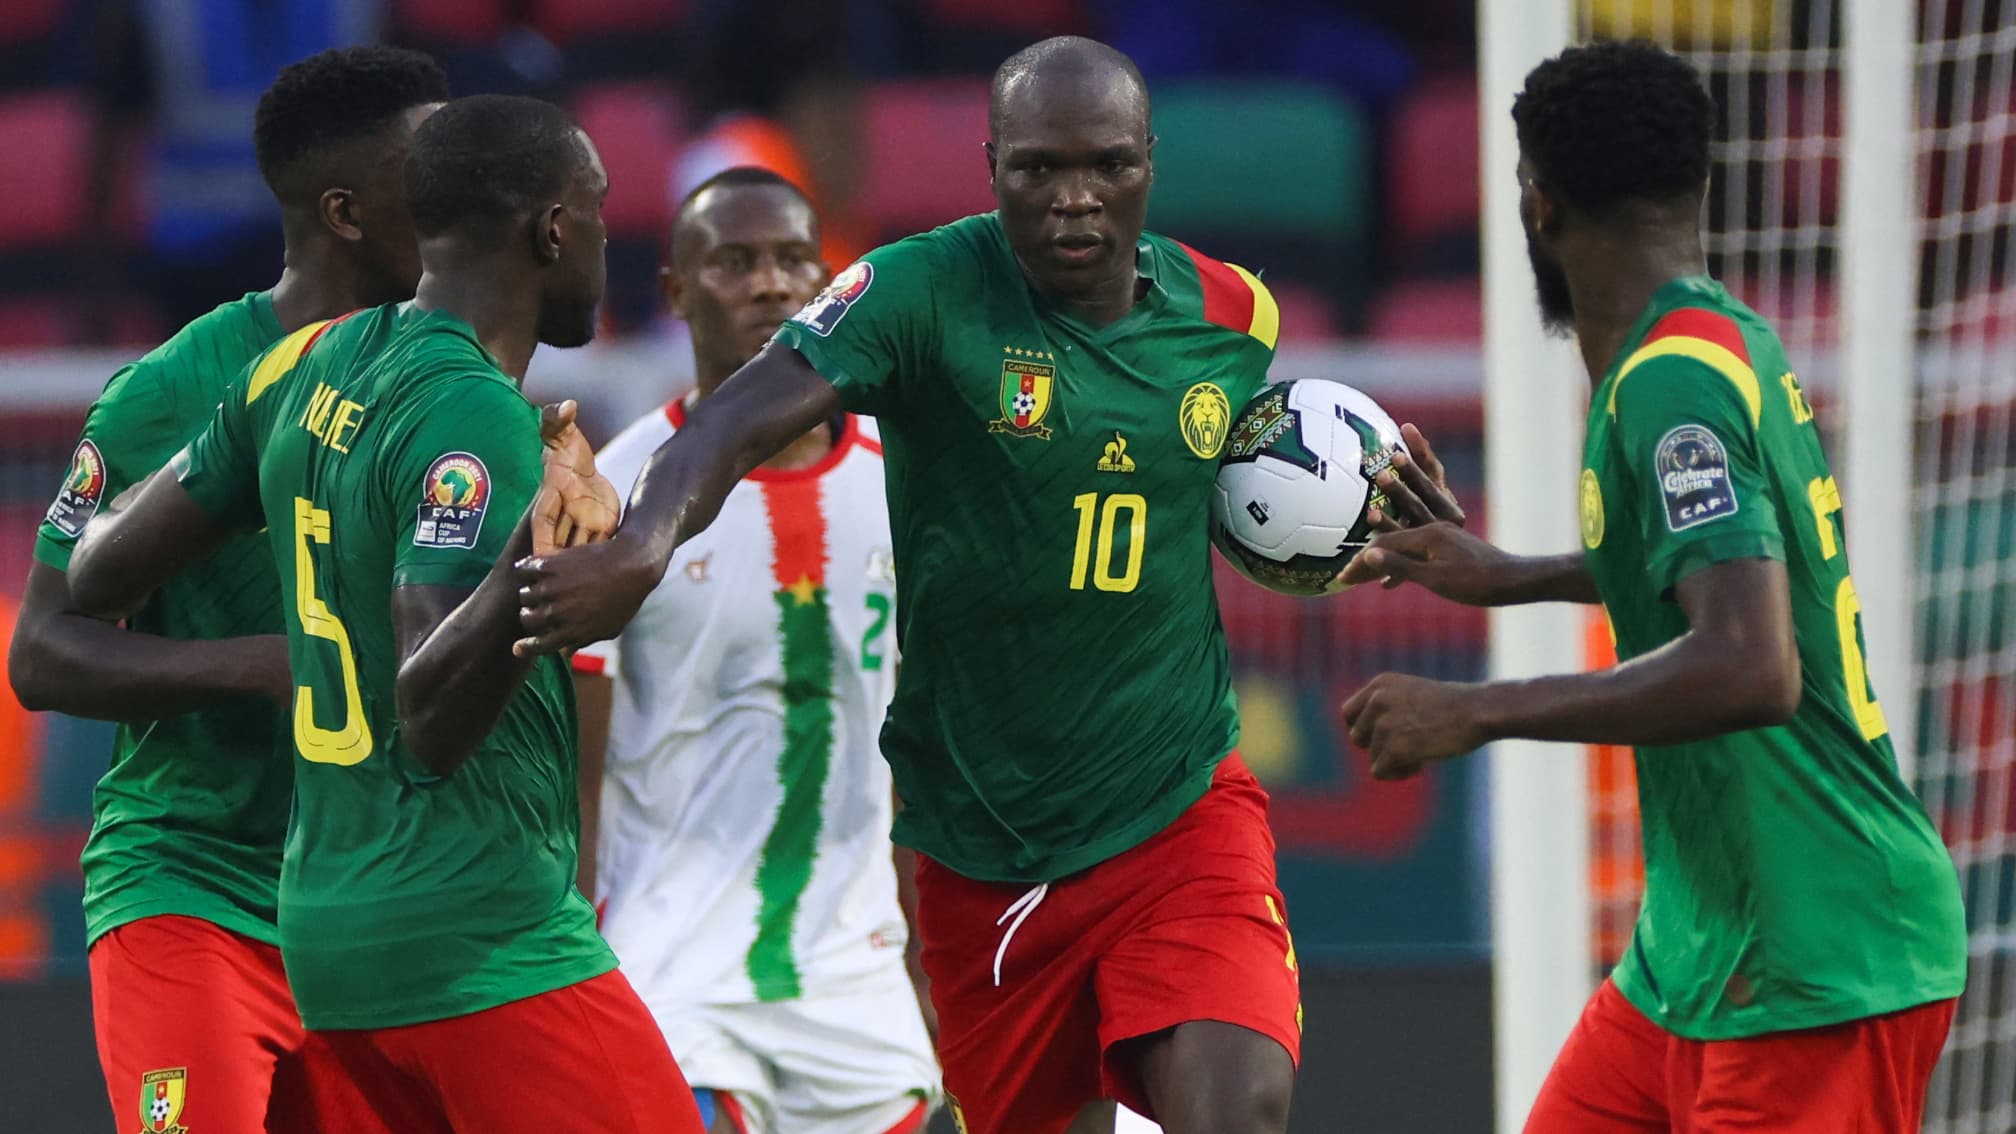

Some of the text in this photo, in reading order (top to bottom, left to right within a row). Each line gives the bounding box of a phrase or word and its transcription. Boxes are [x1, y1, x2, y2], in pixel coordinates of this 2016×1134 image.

[1008, 363, 1051, 376] CAMEROUN
[432, 459, 470, 480] CAMEROON
[432, 507, 471, 520] CAF
[1680, 498, 1720, 520] CAF
[1069, 492, 1147, 593] 10
[294, 496, 374, 767] 5
